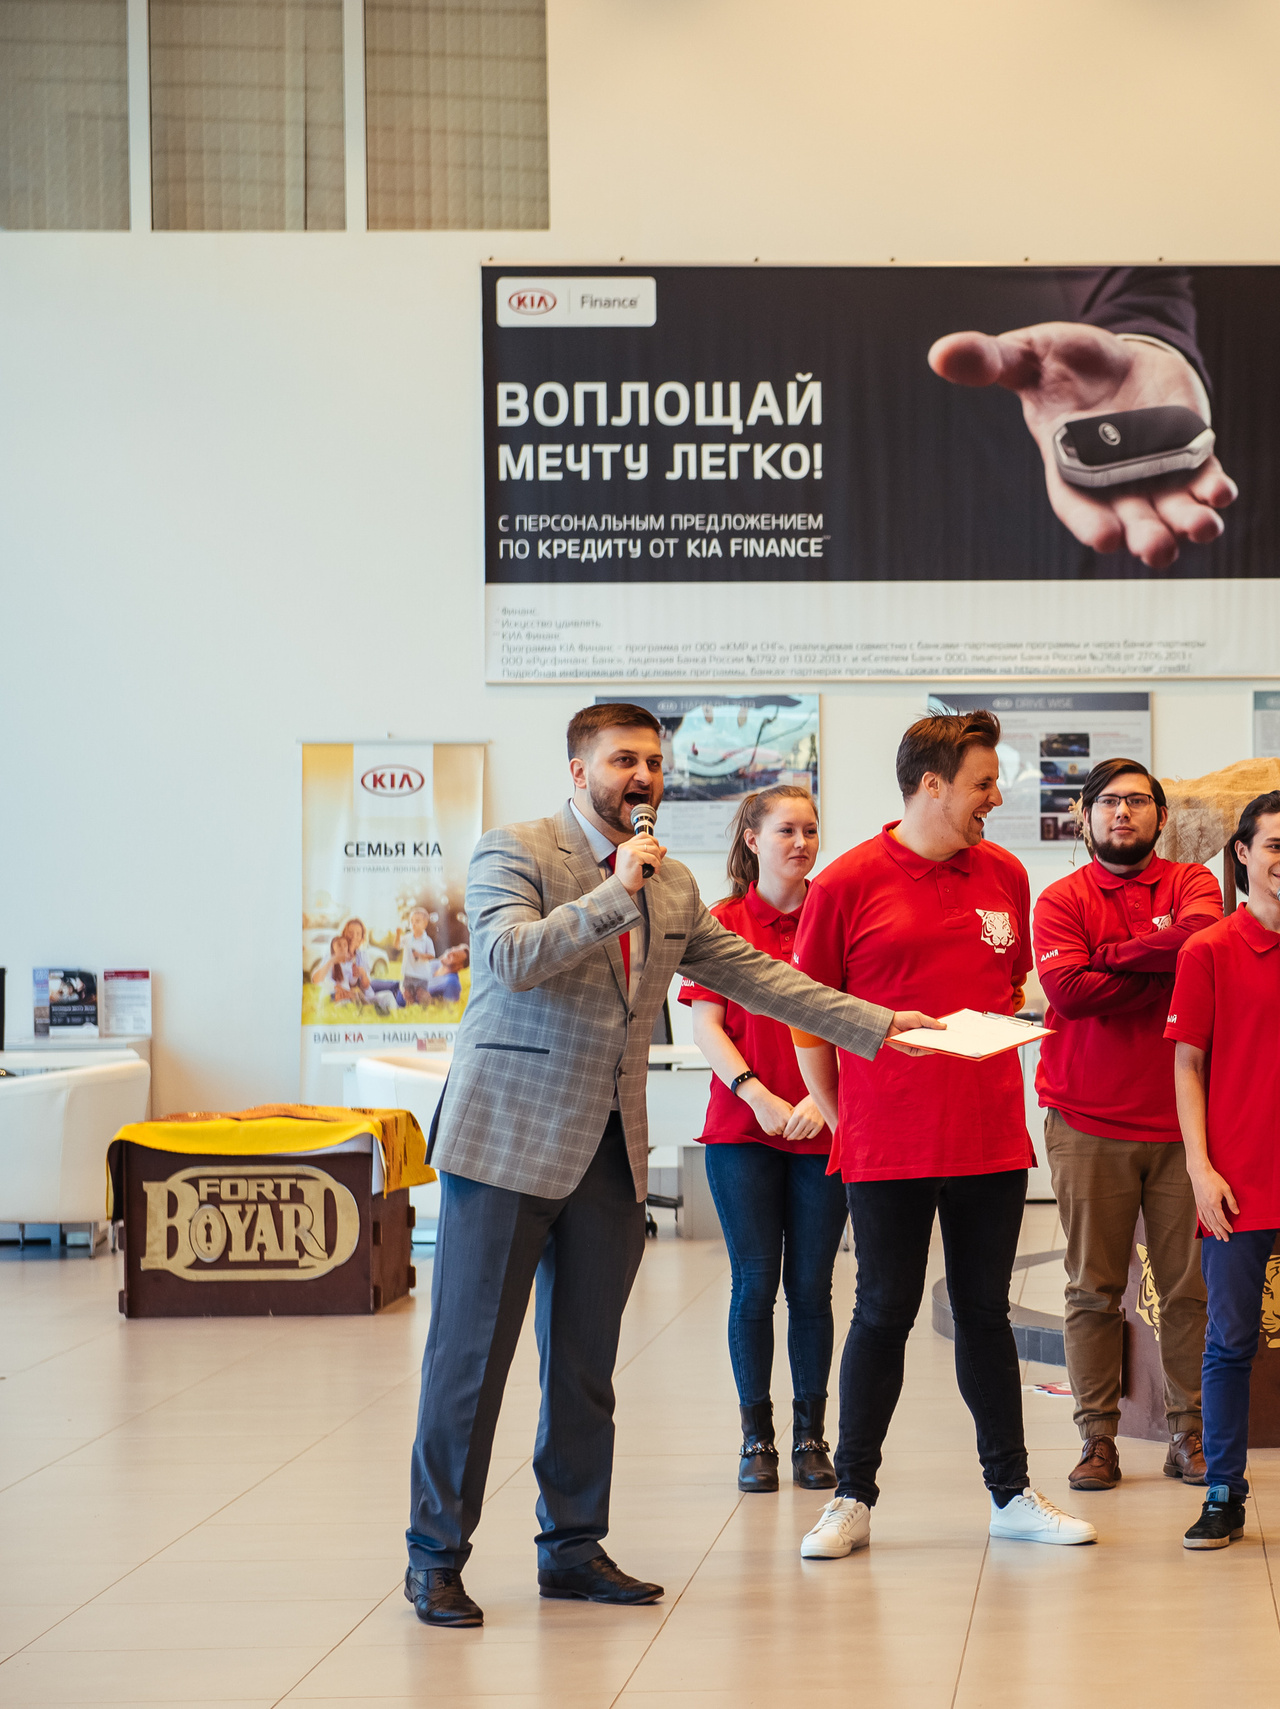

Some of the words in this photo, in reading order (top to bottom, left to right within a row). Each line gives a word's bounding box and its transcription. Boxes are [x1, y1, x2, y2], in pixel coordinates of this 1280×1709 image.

[516, 294, 550, 310] KIA
[580, 293, 638, 309] Finance
[497, 372, 823, 434] ВОПЛОЩАЙ
[498, 443, 649, 482] МЕЧТУ
[665, 442, 824, 481] ЛЕГКО!
[498, 515, 510, 532] С
[515, 513, 665, 533] ПЕРСОНАЛЬНЫМ
[671, 513, 824, 535] ПРЕДЛОЖЕНИЕМ
[499, 540, 530, 559] ПО
[537, 539, 641, 563] КРЕДИТУ
[649, 539, 679, 558] ОТ
[686, 538, 723, 558] KIA
[372, 772, 414, 789] KIA
[344, 841, 406, 858] СЕМЬЯ
[413, 841, 443, 857] KIA
[1040, 949, 1059, 962] ДАНЯ
[313, 1032, 341, 1044] ВАШ
[344, 1031, 365, 1043] KIA
[383, 1031, 419, 1043] НАША
[199, 1178, 297, 1201] FORT
[140, 1180, 360, 1271] BOYARD
